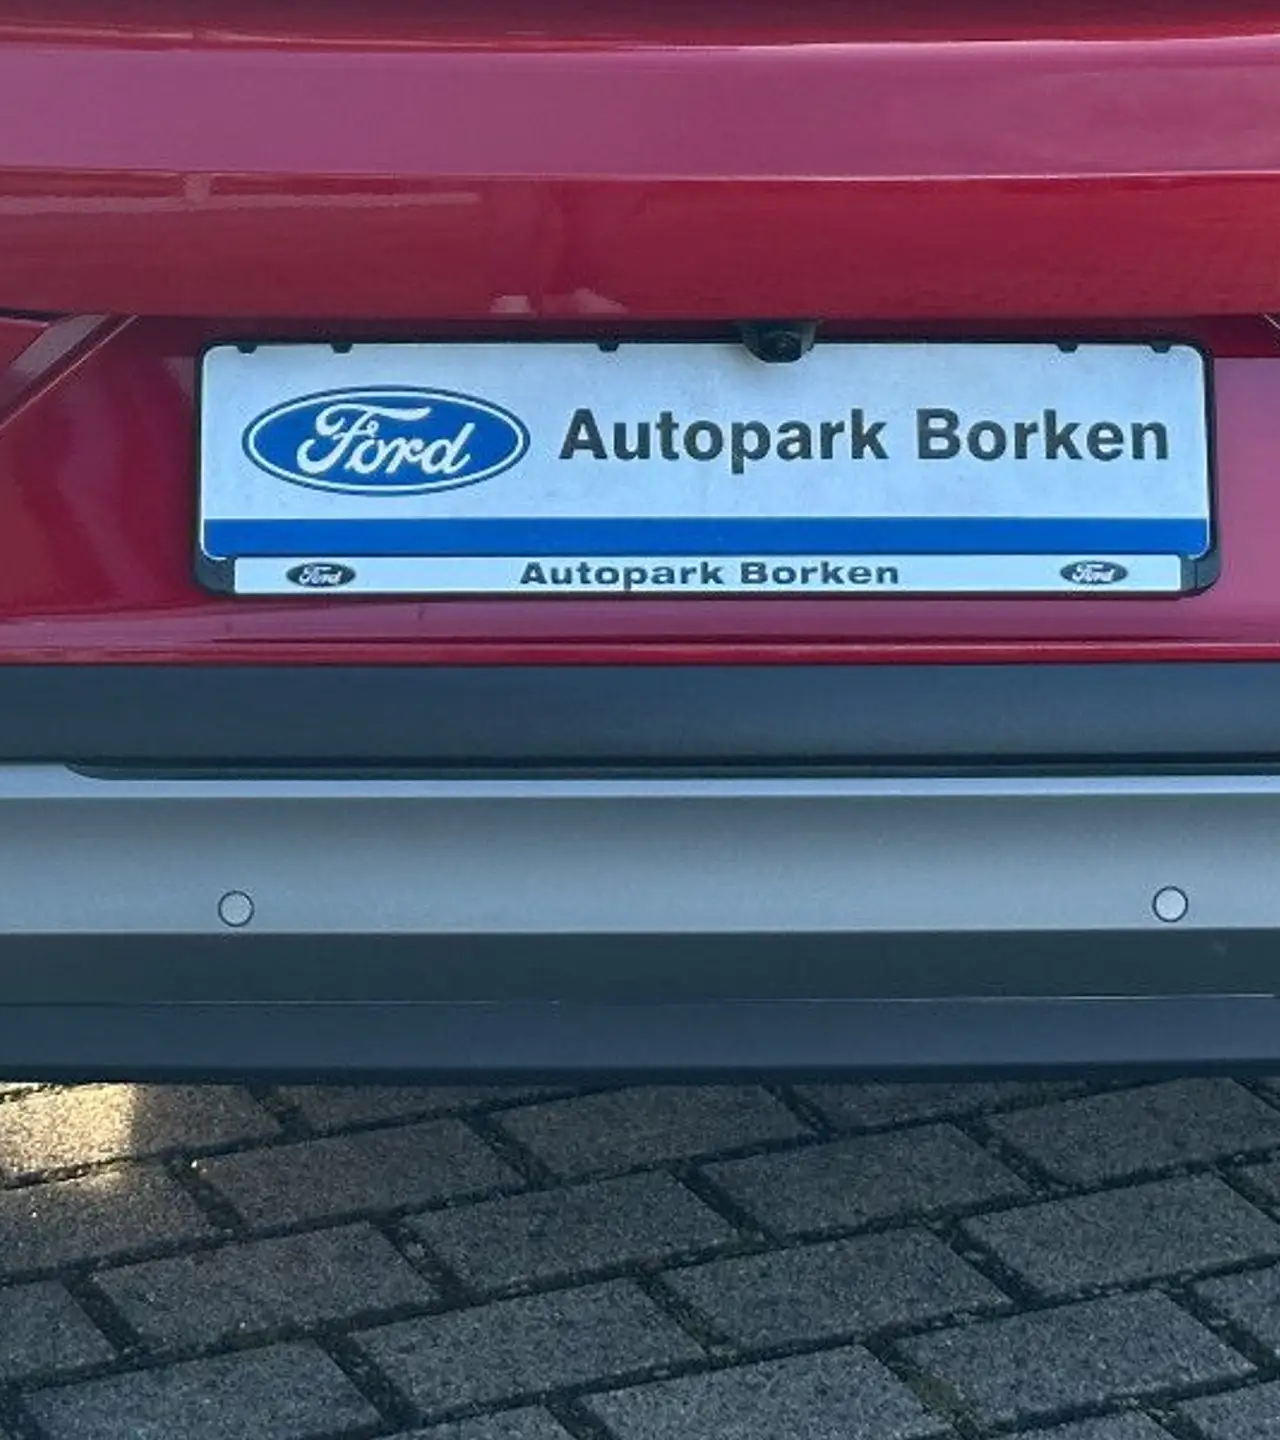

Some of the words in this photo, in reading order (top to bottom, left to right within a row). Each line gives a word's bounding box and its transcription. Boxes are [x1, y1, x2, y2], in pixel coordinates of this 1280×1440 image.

[294, 402, 476, 476] Ford
[559, 408, 888, 474] Autopark
[916, 408, 1170, 462] Borken
[296, 563, 345, 586] Ford
[519, 560, 726, 589] Autopark
[740, 560, 900, 585] Borken
[1069, 563, 1119, 586] Ford
